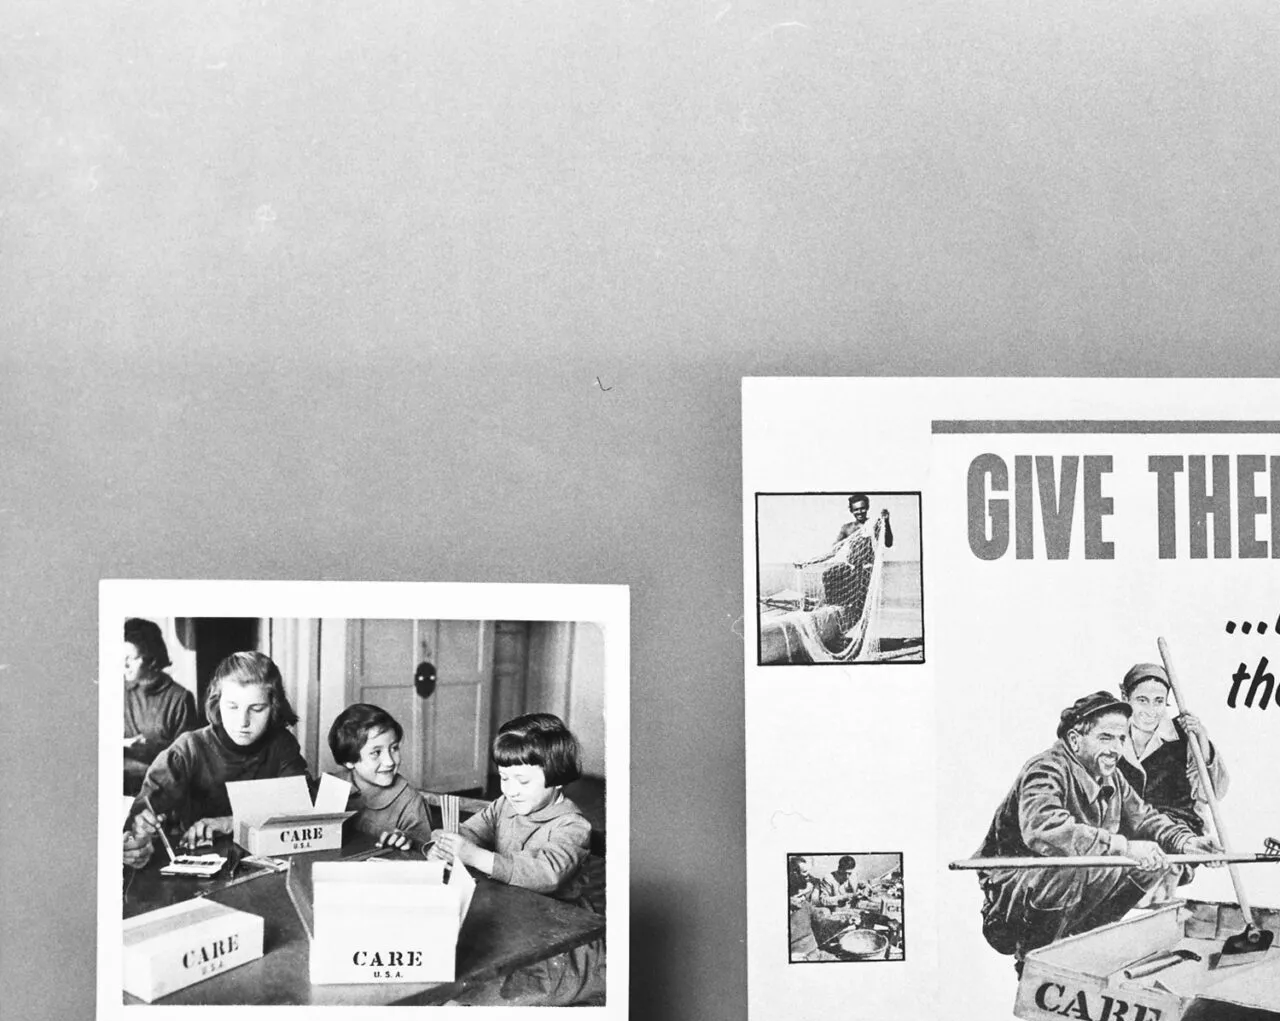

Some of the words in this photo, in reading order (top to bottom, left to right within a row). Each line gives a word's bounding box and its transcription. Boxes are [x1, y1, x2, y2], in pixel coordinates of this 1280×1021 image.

[967, 453, 1115, 560] GIVE
[280, 827, 323, 842] CARE
[183, 934, 239, 969] CARE
[353, 952, 422, 966] CARE
